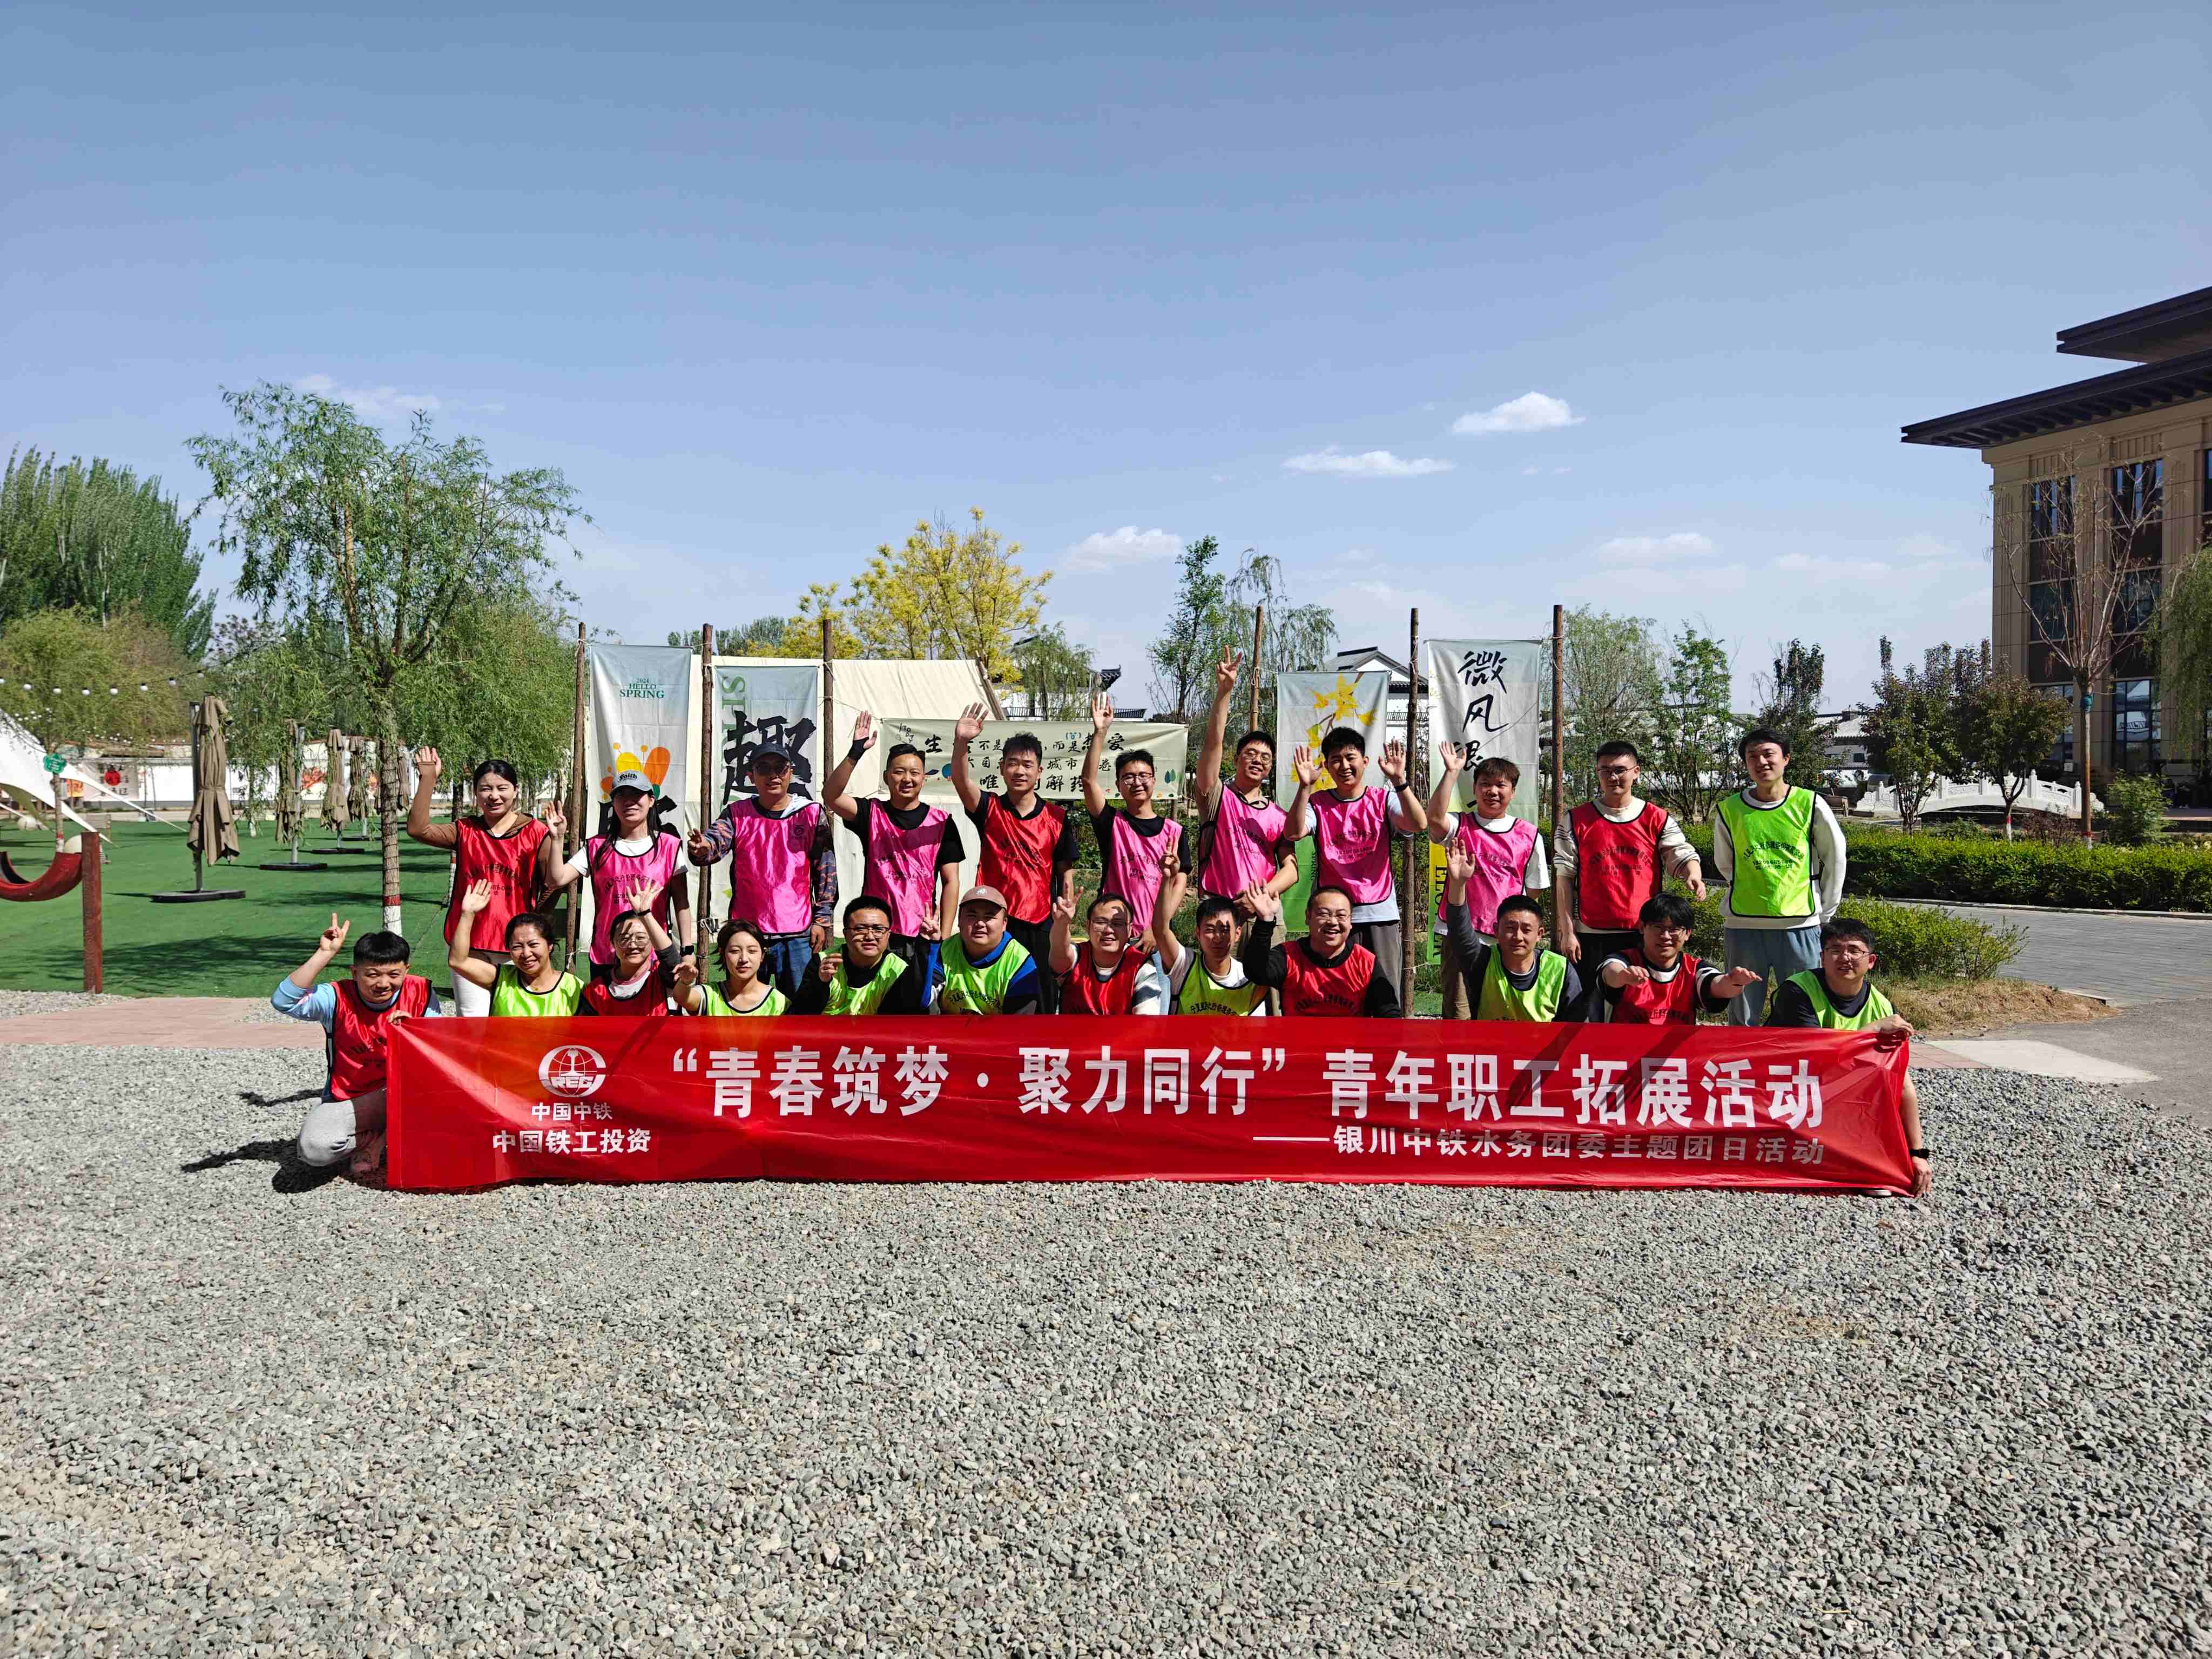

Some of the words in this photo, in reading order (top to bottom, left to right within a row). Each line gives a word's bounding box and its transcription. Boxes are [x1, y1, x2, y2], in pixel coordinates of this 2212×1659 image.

[619, 689, 665, 698] SPRING
[1323, 1049, 1823, 1130] 青年职工拓展活动
[531, 1102, 613, 1121] 中国中铁
[493, 1128, 651, 1155] 中国铁工投资
